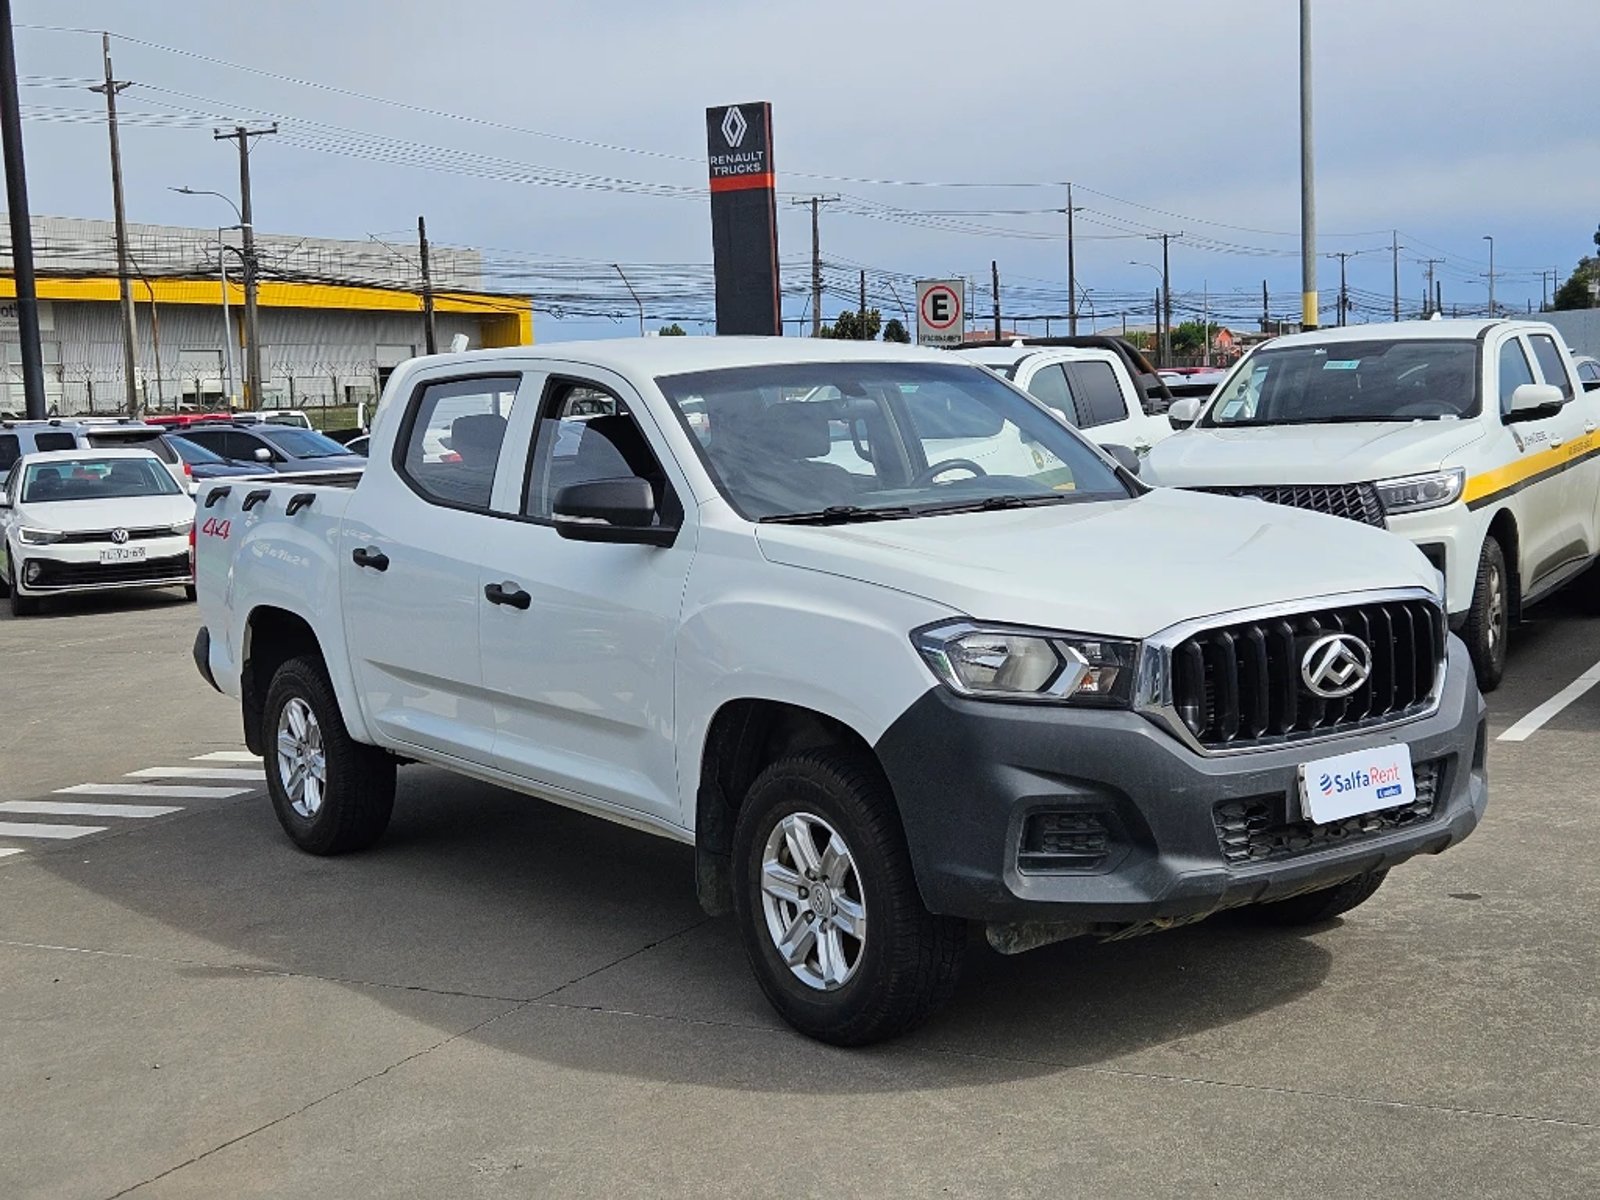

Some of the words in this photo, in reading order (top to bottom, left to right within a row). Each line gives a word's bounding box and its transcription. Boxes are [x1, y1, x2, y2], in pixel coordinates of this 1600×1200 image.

[710, 151, 764, 165] RENAULT
[713, 163, 761, 176] TRUCKS
[932, 294, 949, 321] E
[1334, 764, 1400, 793] SalfaRent
